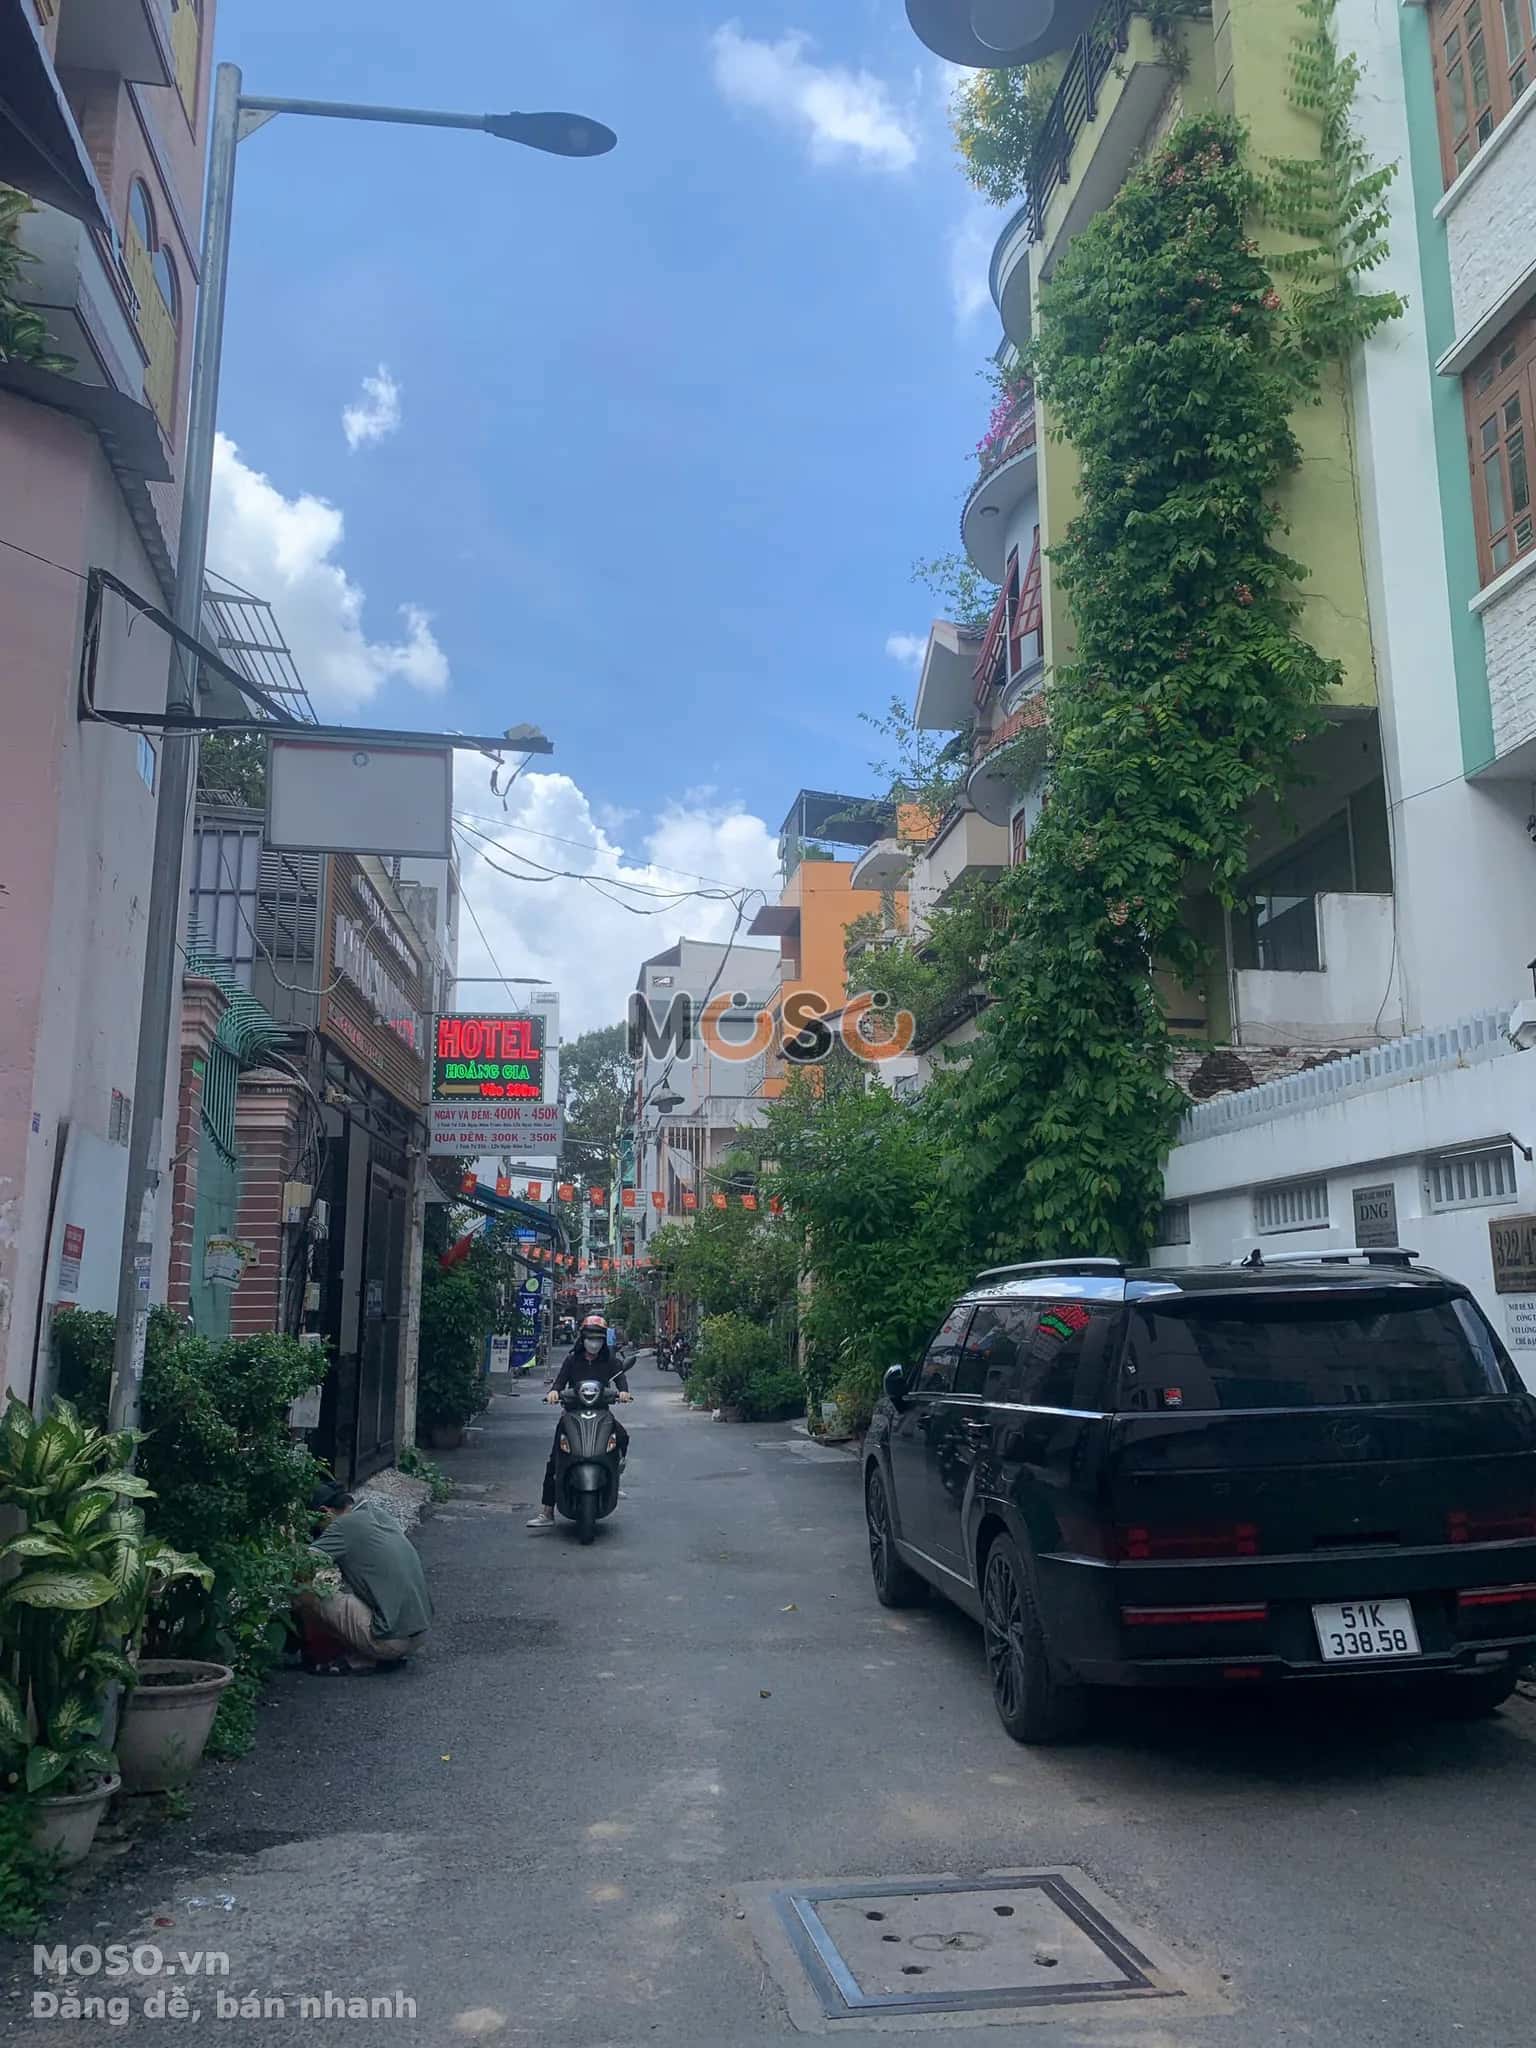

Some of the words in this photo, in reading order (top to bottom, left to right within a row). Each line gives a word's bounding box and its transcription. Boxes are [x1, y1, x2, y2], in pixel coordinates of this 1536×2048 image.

[438, 1019, 539, 1060] HOTEL
[502, 1064, 530, 1080] GIA
[494, 1107, 521, 1120] 400K
[531, 1107, 558, 1120] 450K
[434, 1133, 456, 1143] QUA
[491, 1133, 518, 1142] 300K
[529, 1133, 557, 1142] 350K
[1360, 1202, 1389, 1221] DNG
[523, 1297, 535, 1306] XE
[1341, 1604, 1385, 1628] 51K
[1330, 1629, 1408, 1656] 338.58
